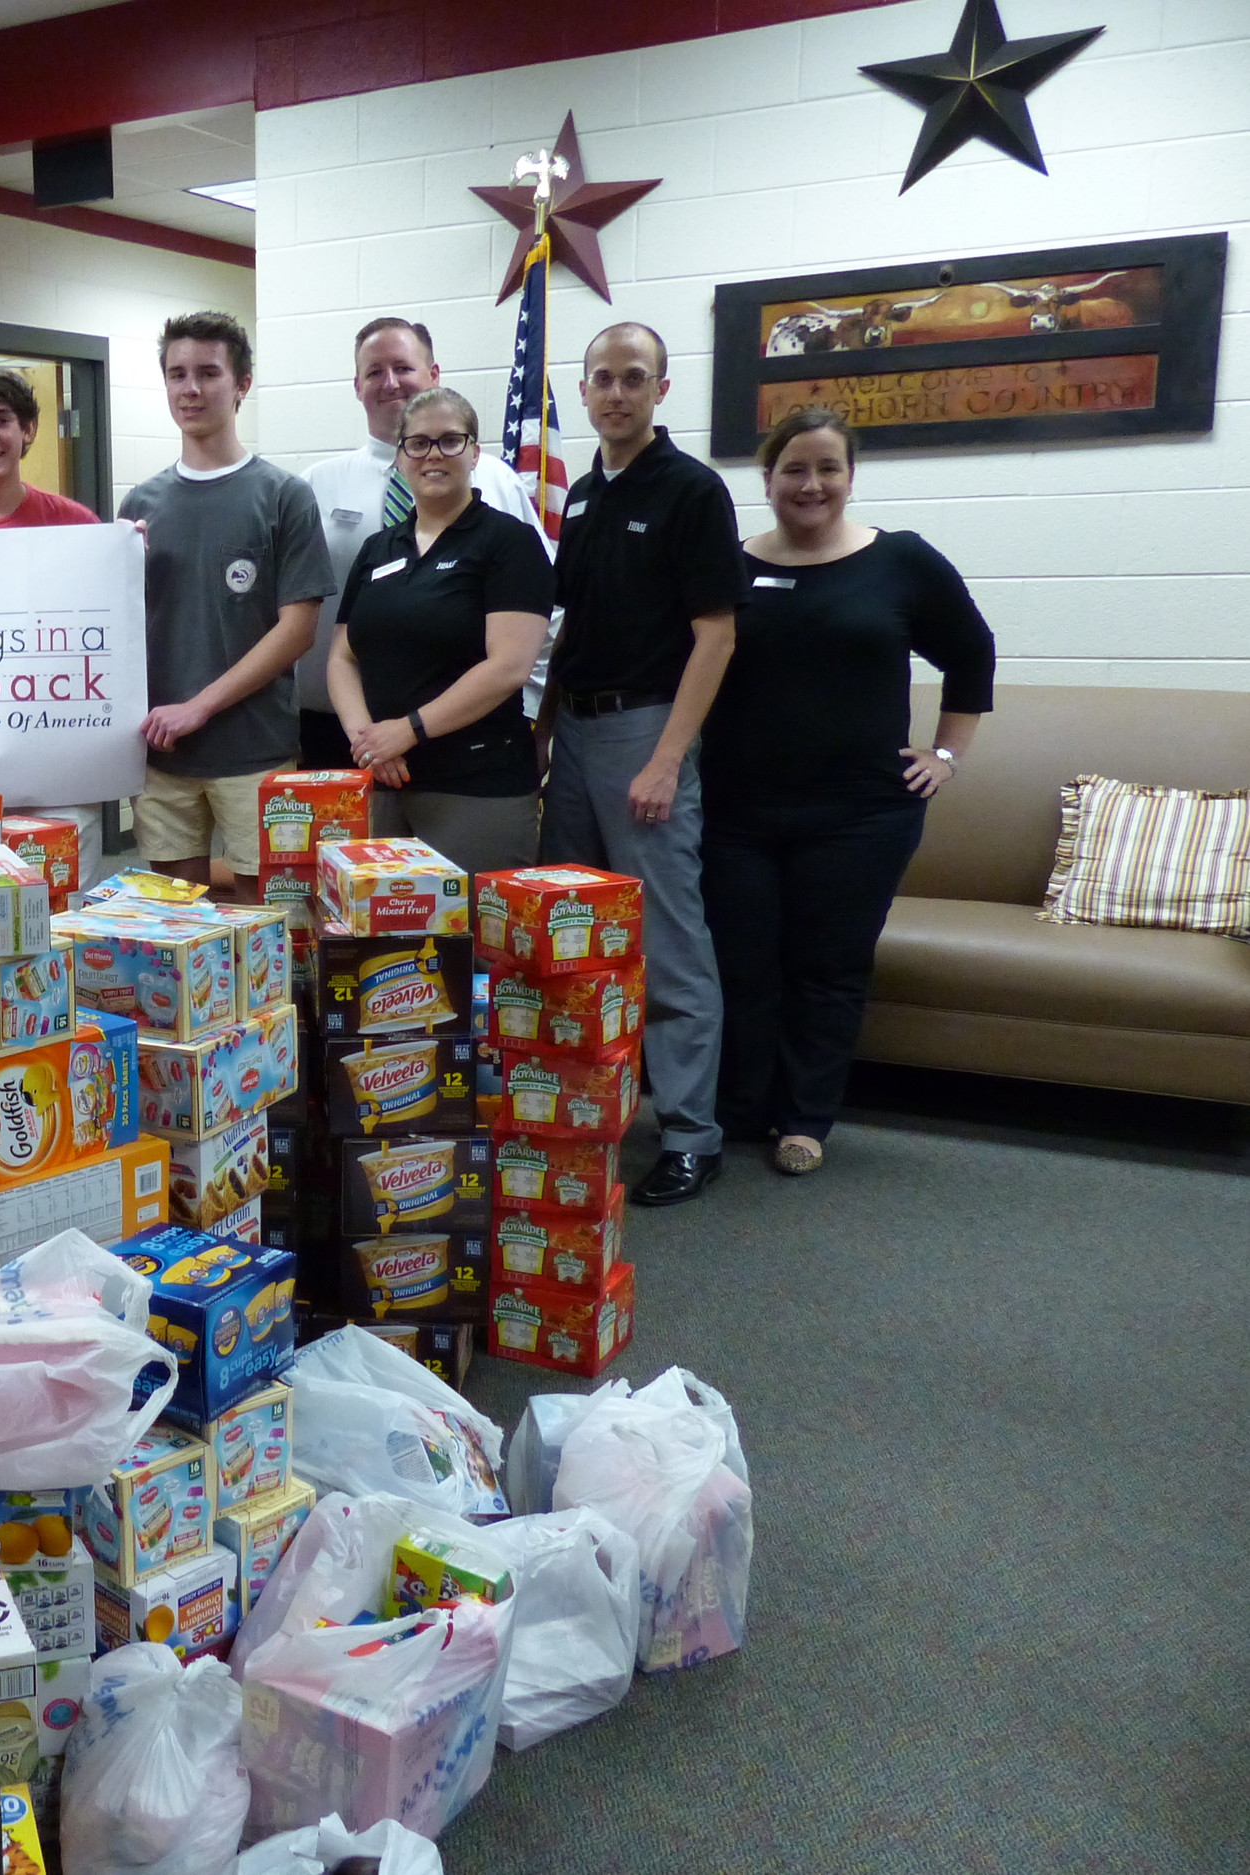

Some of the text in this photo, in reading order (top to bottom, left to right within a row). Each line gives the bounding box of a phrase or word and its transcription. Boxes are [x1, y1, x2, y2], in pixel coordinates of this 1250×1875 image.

[37, 620, 68, 651] in
[82, 626, 105, 651] a
[8, 711, 32, 733] Of
[35, 711, 112, 729] America
[265, 802, 312, 815] BOYARDEE
[265, 881, 311, 892] BOYARDEE
[446, 882, 457, 891] 16
[389, 898, 415, 907] Cherry
[376, 906, 428, 915] Mixed Fruit
[550, 903, 593, 918] BOYARDEE
[163, 952, 171, 961] 16
[375, 964, 415, 983] ORIGINAL
[334, 988, 353, 1001] 12
[371, 983, 434, 1014] Velveeta
[495, 984, 541, 999] BOYARDEE
[363, 1060, 425, 1092] Velveeta
[443, 1073, 462, 1085] 12
[510, 1069, 559, 1083] BOYARDEE
[382, 1091, 421, 1111] ORIGINAL
[0, 1080, 32, 1159] Goldfish
[122, 1114, 128, 1126] 30
[498, 1147, 547, 1162] BOYARDEE
[381, 1161, 442, 1190] Velveeta
[461, 1174, 479, 1186] 12
[399, 1191, 438, 1210] ORIGINAL
[500, 1222, 547, 1239] BOYARDEE
[375, 1251, 436, 1279] Velveeta
[455, 1267, 474, 1279] 12
[393, 1282, 432, 1297] ORIGINAL
[495, 1299, 540, 1318] BOYARDEE
[246, 1345, 277, 1377] easy
[220, 1352, 252, 1389] 8 cups
[274, 1405, 282, 1414] 16
[190, 1463, 200, 1472] 16
[36, 1559, 47, 1567] 16
[186, 1594, 222, 1616] Oranges
[180, 1603, 222, 1630] Mandarin
[192, 1618, 223, 1642] Dole
[1, 1752, 19, 1765] 36
